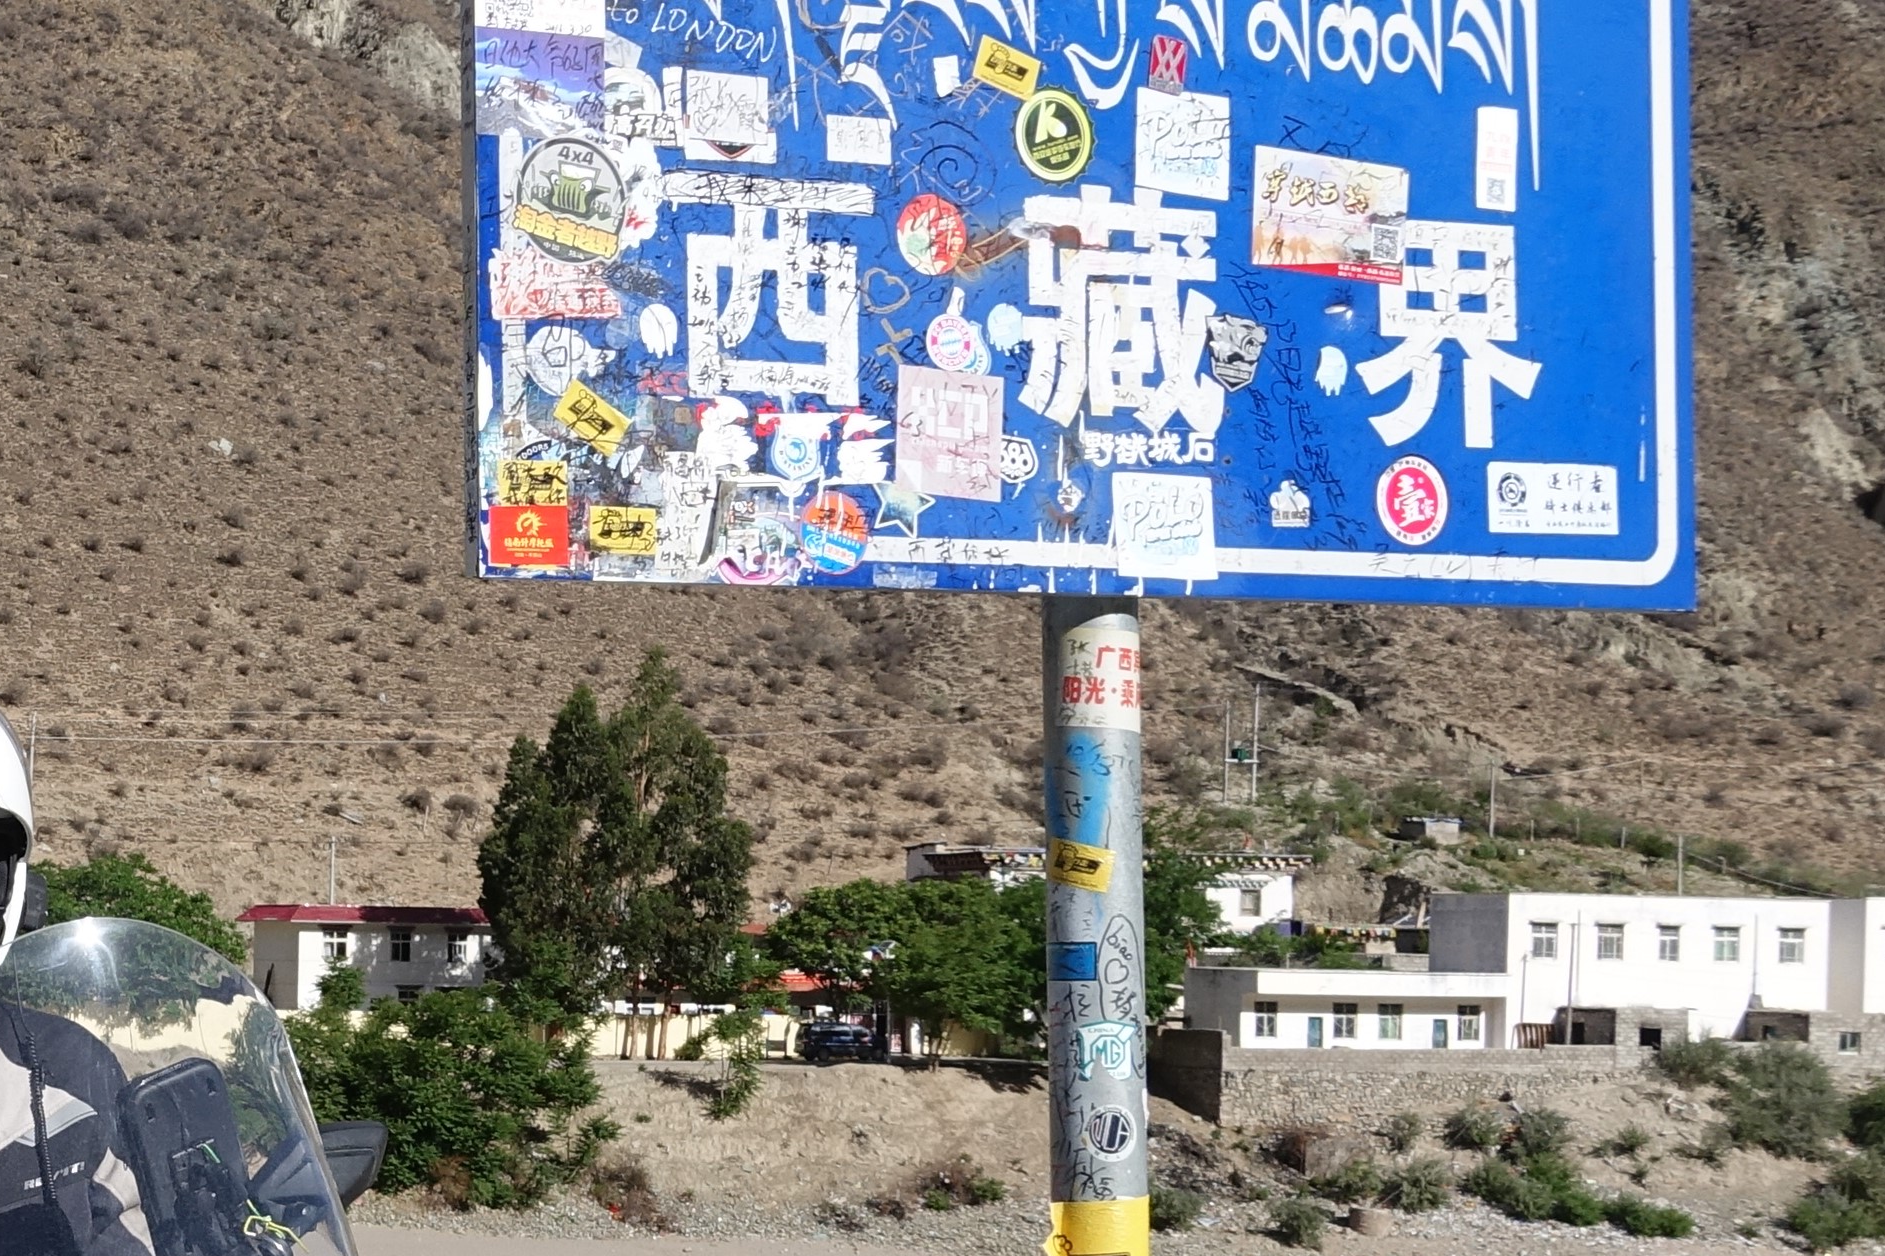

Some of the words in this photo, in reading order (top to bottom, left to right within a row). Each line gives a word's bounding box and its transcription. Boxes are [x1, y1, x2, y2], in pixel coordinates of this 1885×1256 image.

[651, 3, 778, 63] LONDON
[557, 145, 595, 166] 4x4
[512, 204, 619, 260] 淘金者越野
